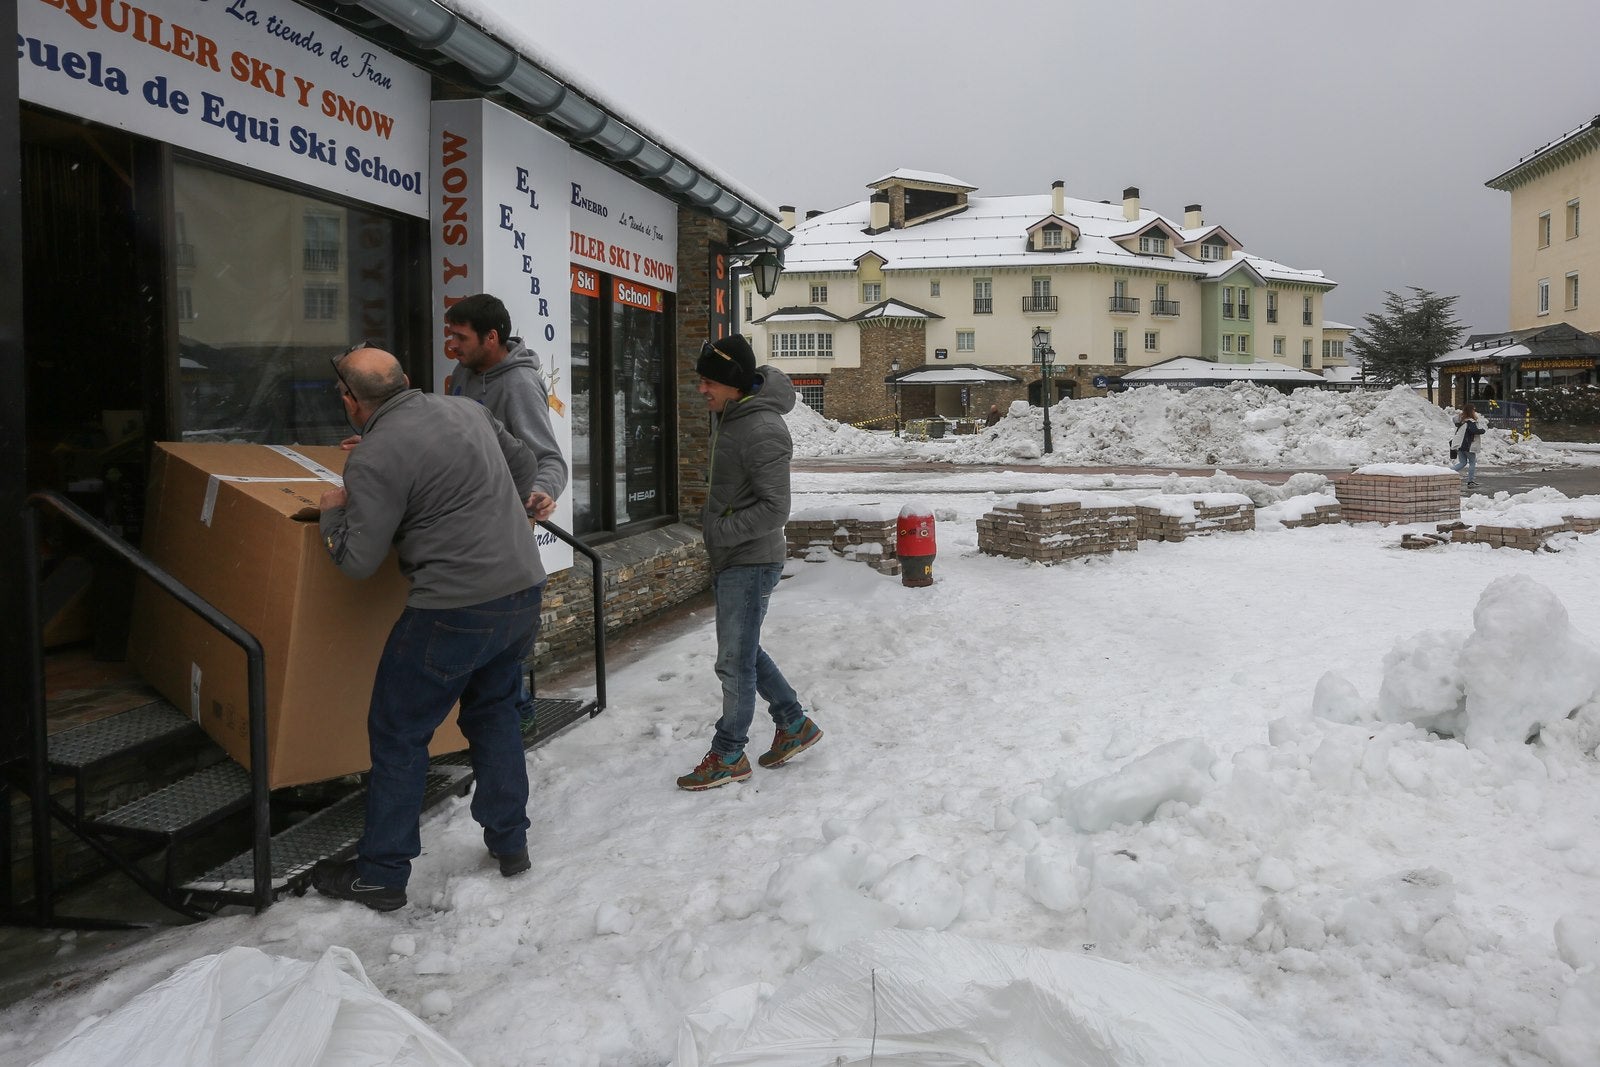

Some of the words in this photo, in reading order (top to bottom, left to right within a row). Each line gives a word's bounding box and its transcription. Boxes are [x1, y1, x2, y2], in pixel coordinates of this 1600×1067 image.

[225, 0, 259, 26] La
[266, 15, 323, 57] tienda
[330, 45, 349, 69] de
[352, 52, 392, 90] Fran
[230, 51, 286, 98] SKI
[294, 76, 315, 107] Y
[321, 89, 395, 140] SNOW
[142, 75, 190, 115] de
[200, 90, 280, 146] Equi
[289, 125, 337, 166] Ski
[345, 146, 422, 195] School
[442, 130, 468, 246] SNOW
[516, 166, 539, 210] EL
[571, 182, 608, 218] ENEBRO
[443, 256, 468, 285] Y
[499, 203, 555, 341] ENEBRO
[609, 244, 630, 270] SKI
[632, 252, 642, 273] Y
[643, 257, 674, 284] SNOW
[577, 270, 594, 291] Ski
[618, 282, 651, 307] School
[628, 489, 656, 502] HEAD
[534, 532, 558, 547] ran
